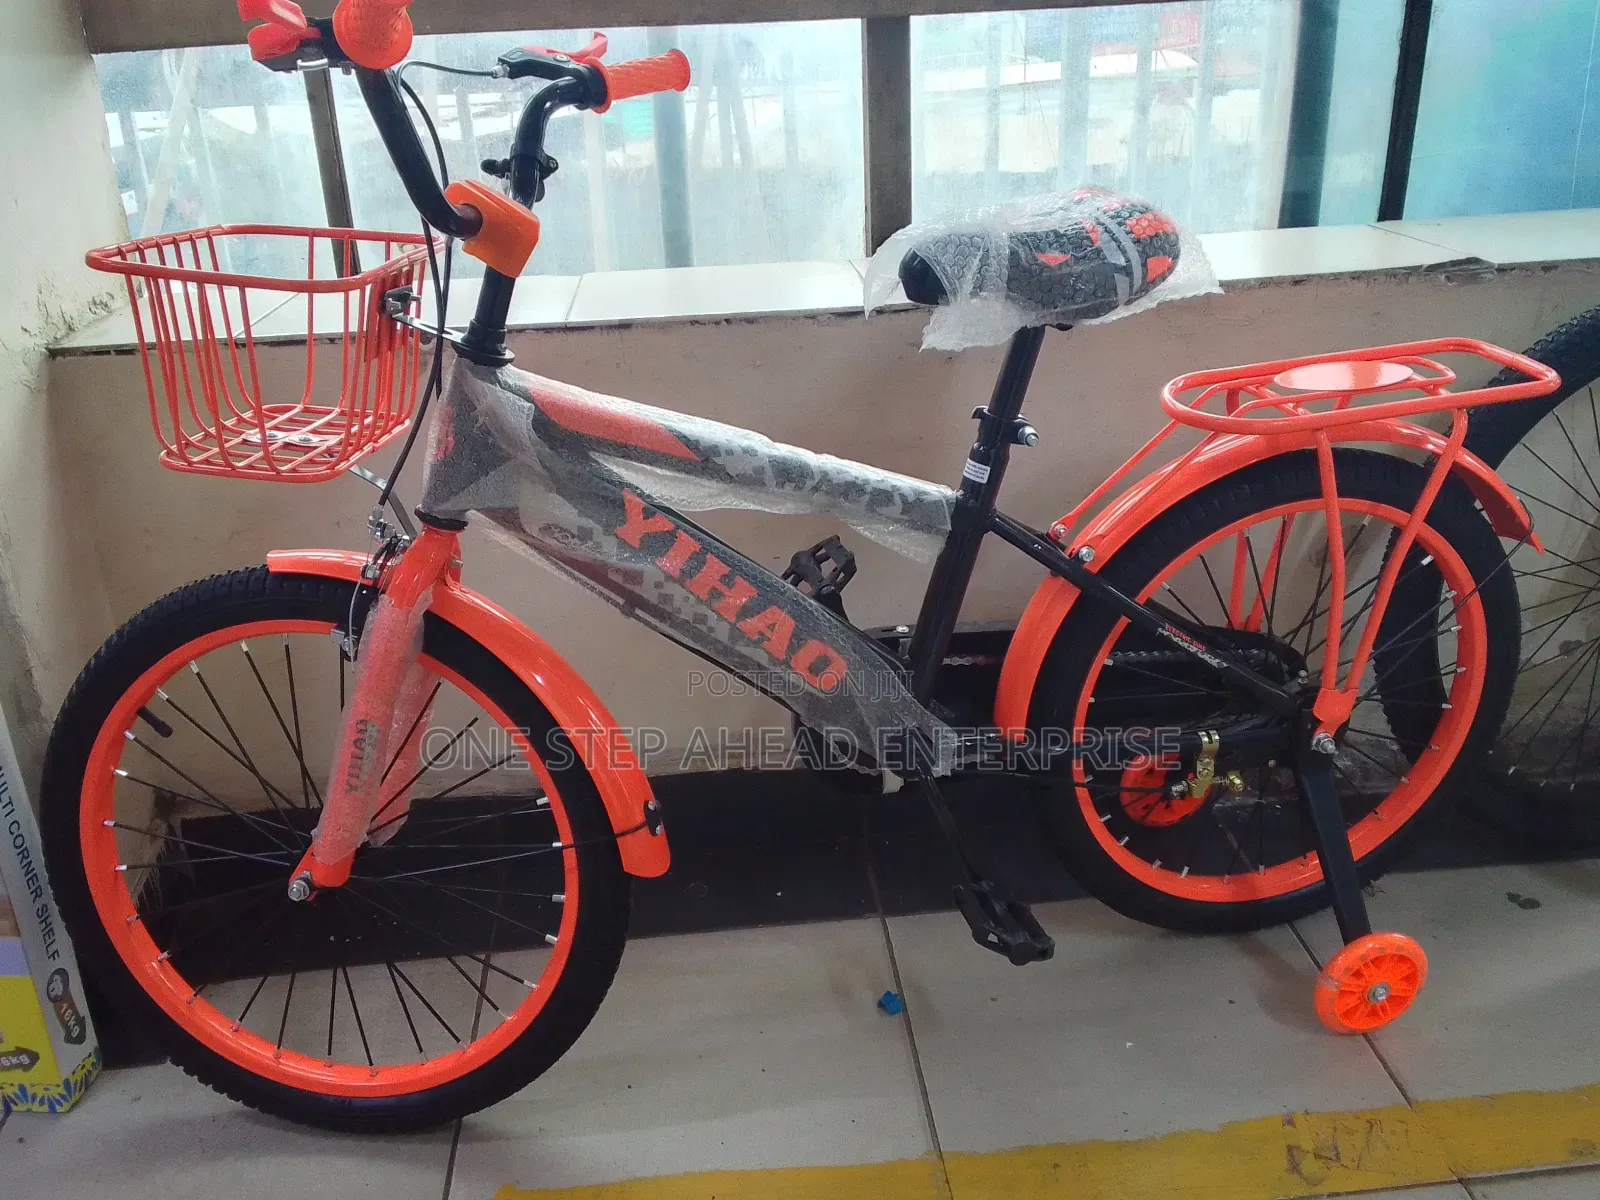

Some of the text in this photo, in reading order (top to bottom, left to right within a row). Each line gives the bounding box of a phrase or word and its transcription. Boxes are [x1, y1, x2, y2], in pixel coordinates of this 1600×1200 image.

[615, 488, 848, 691] YIHAO
[9, 819, 43, 904] CORNER
[36, 903, 60, 961] SHELF
[60, 1003, 80, 1038] 16kg
